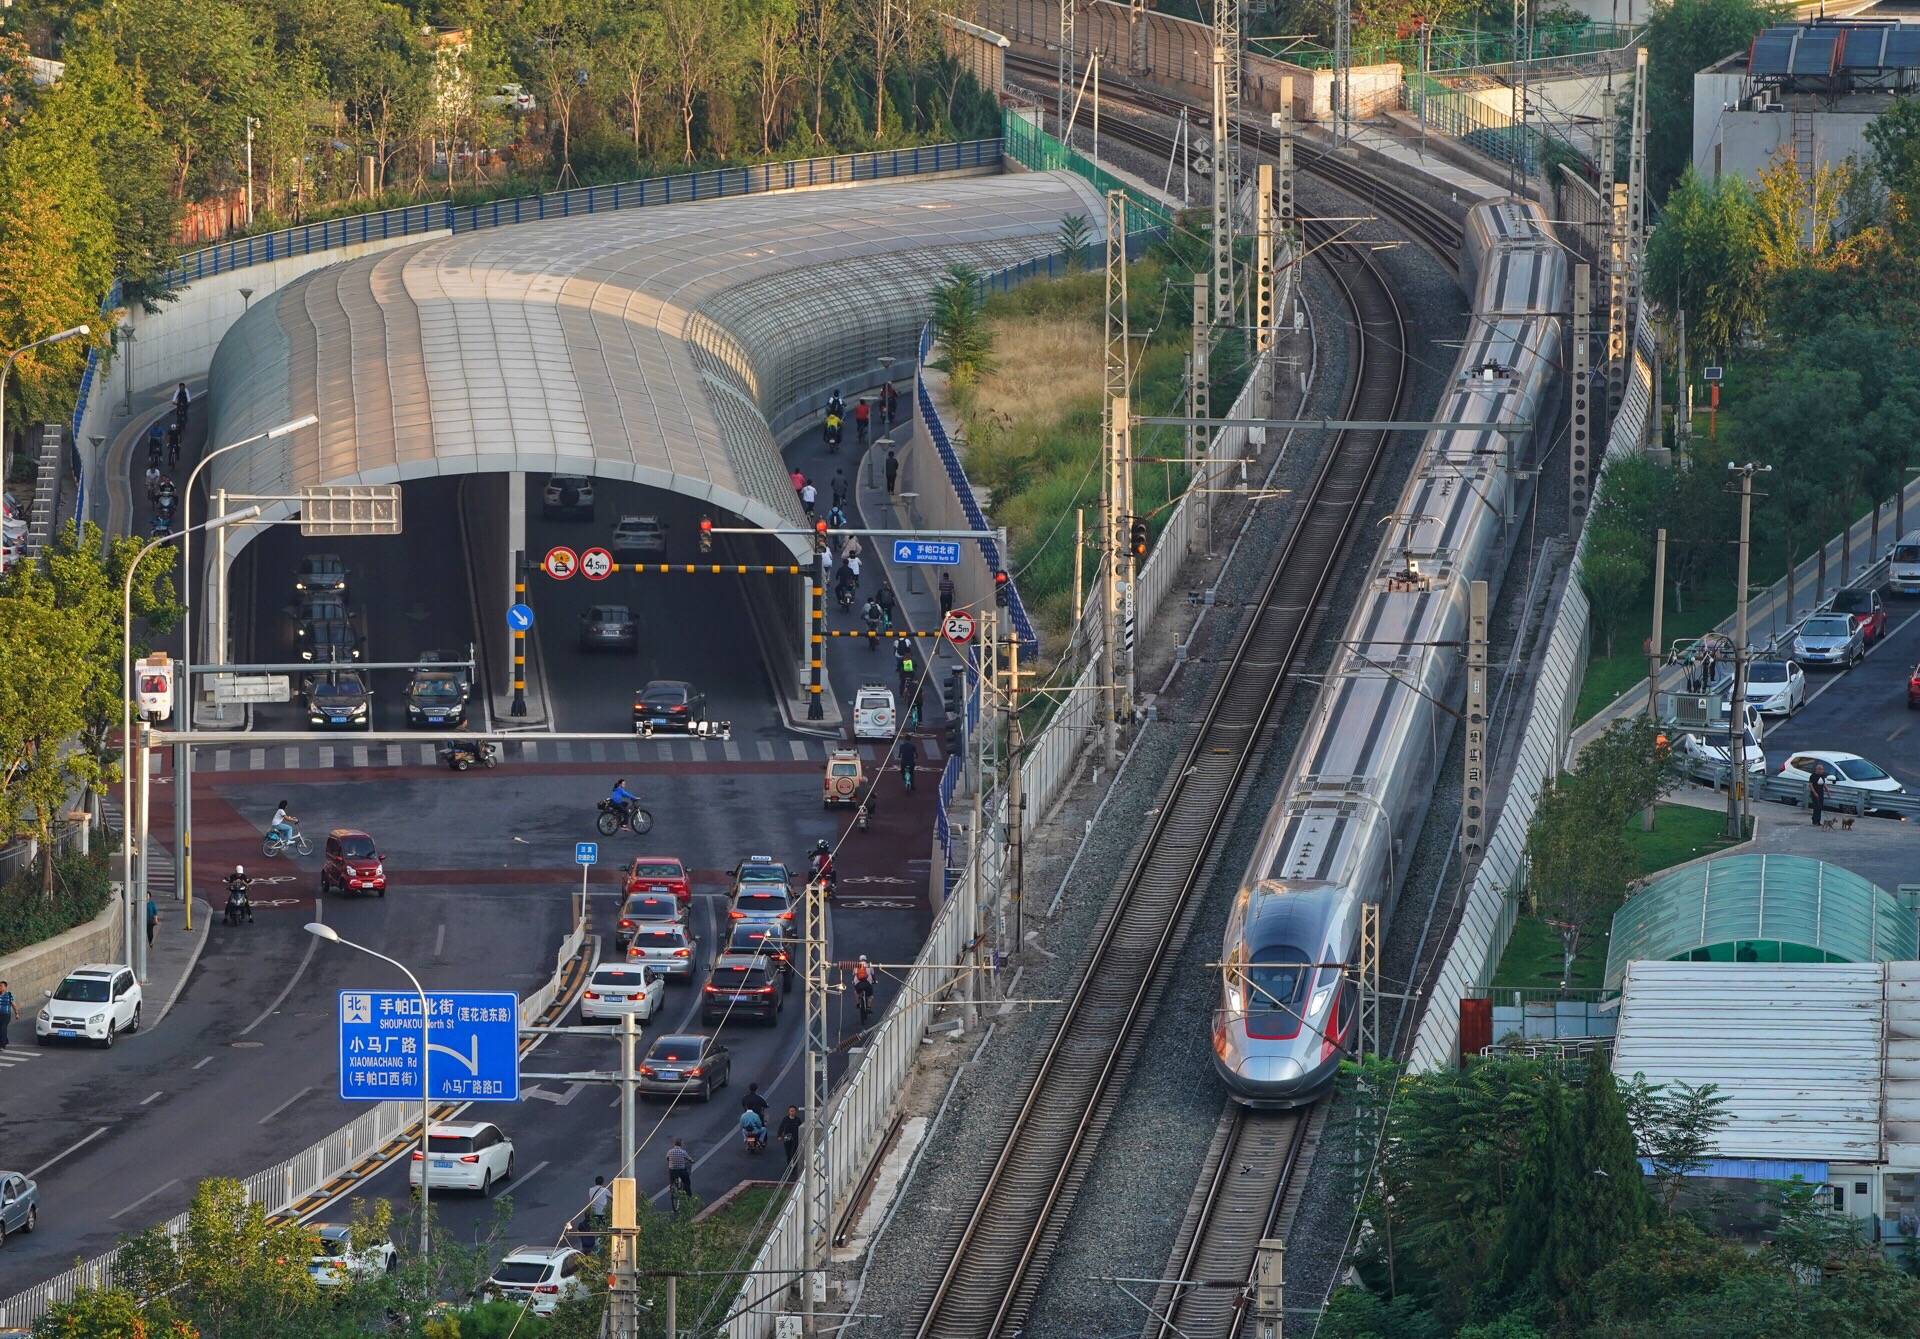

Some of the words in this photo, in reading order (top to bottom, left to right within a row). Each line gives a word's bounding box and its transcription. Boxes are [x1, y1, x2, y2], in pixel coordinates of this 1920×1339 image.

[917, 545, 955, 555] 手帕口北街
[586, 558, 607, 570] 4.5m
[948, 620, 969, 633] 2.5m
[348, 997, 361, 1011] 北
[380, 998, 454, 1016] 手帕口北街
[380, 1019, 423, 1029] SHOUPAKOU
[446, 1019, 455, 1029] St
[350, 1036, 417, 1054] 小马厂路
[350, 1056, 403, 1068] XIAOMACHANG
[407, 1056, 417, 1068] Rd
[442, 1080, 503, 1095] 小马厂路路口
